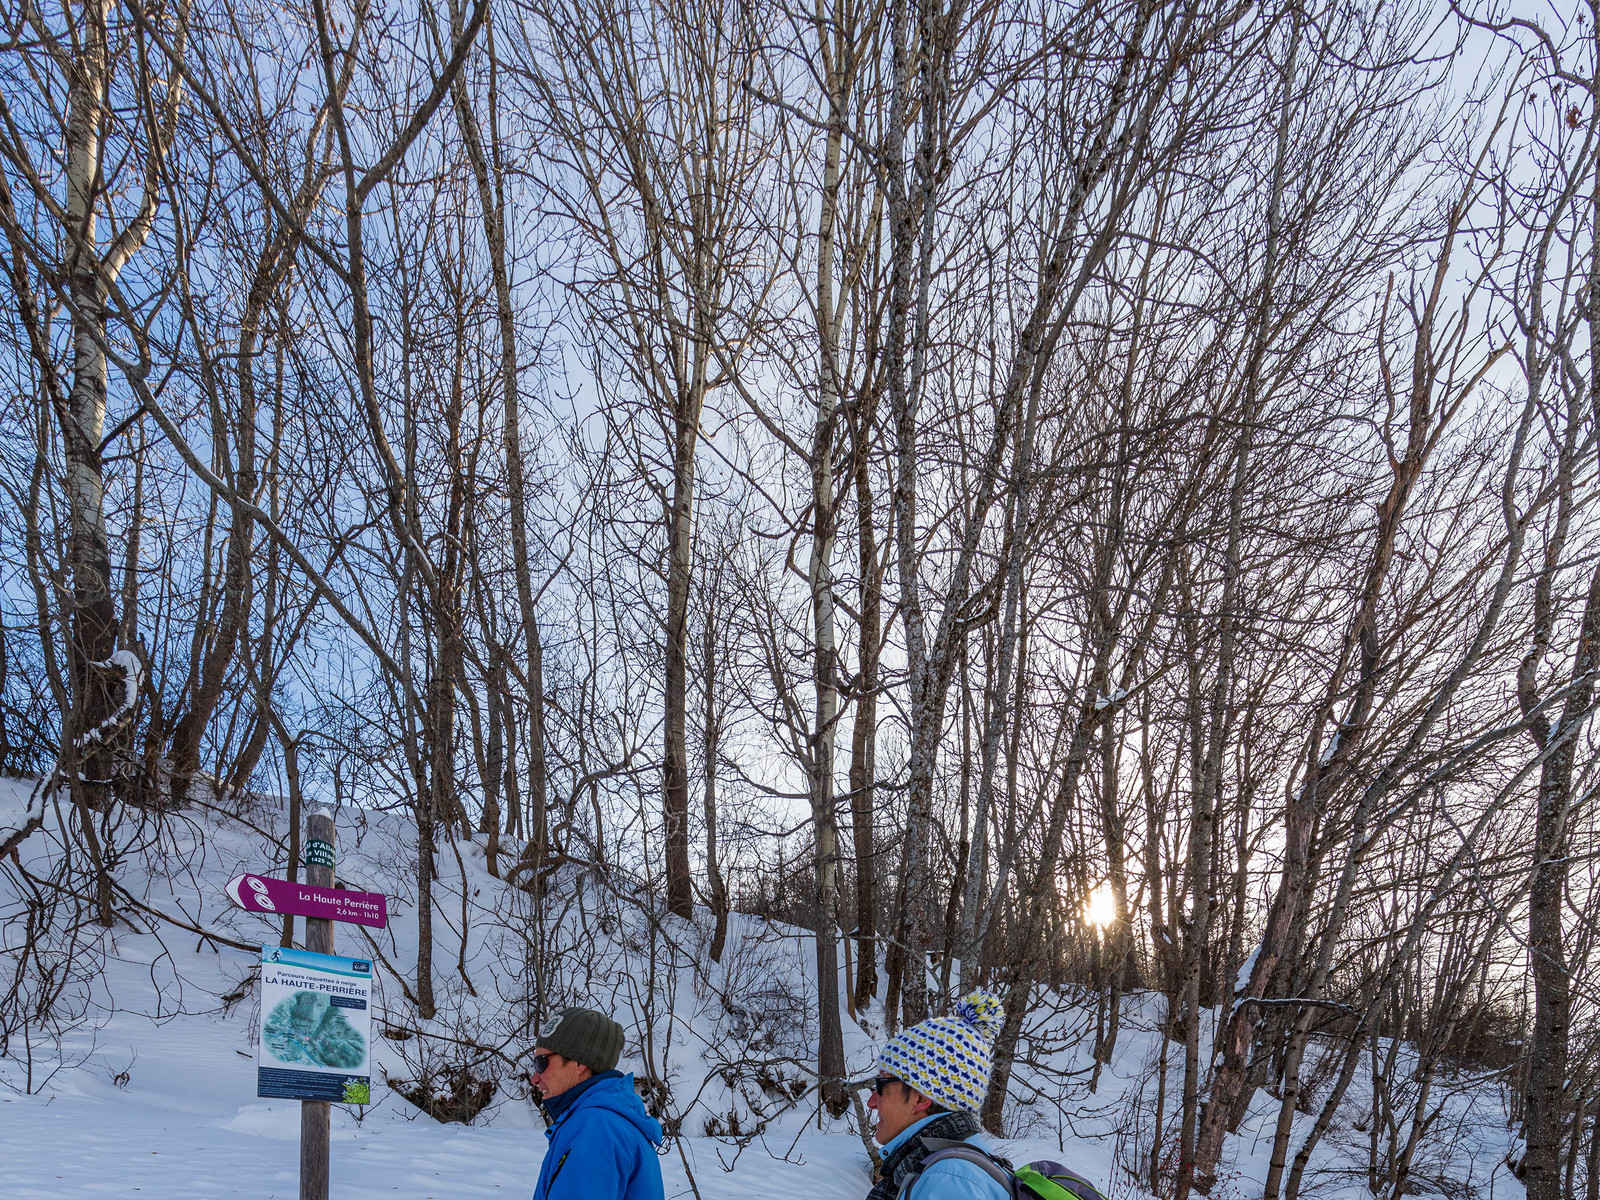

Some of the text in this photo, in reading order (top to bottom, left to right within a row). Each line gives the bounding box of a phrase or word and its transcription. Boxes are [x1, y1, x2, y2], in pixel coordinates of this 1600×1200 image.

[299, 891, 379, 911] La Haute Perrière
[336, 907, 347, 916] 2,6
[348, 909, 358, 917] km
[364, 911, 379, 919] 1h10
[265, 976, 368, 997] LA HAUTE-PERRIÈRE
[277, 971, 305, 980] Parcours
[306, 976, 335, 985] raquettes
[341, 980, 357, 988] neige
